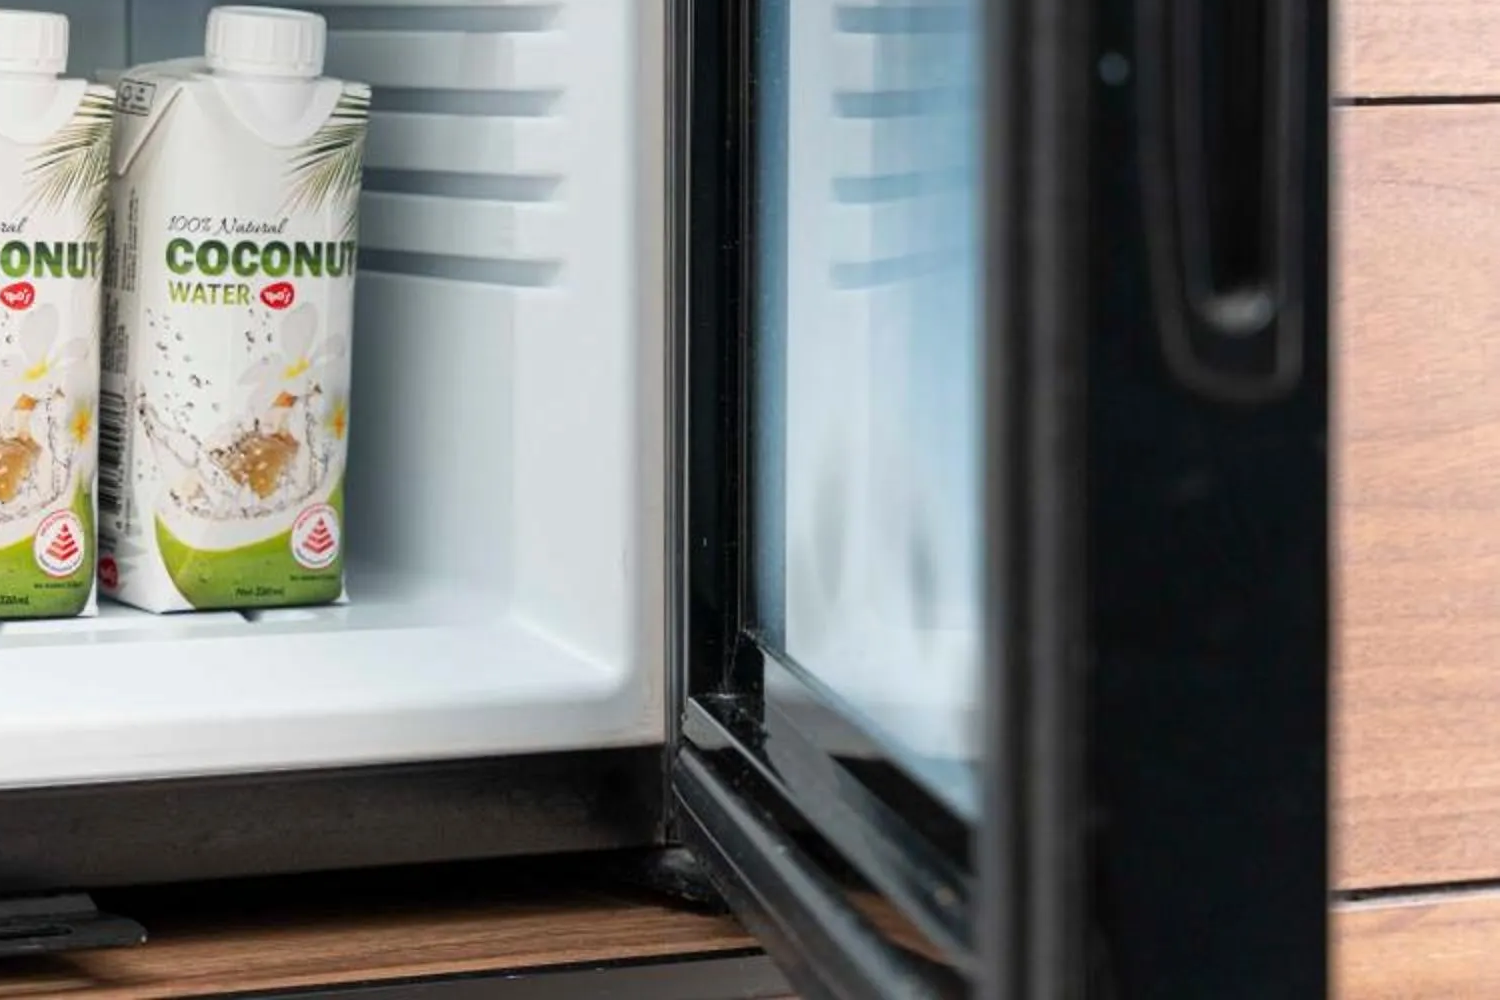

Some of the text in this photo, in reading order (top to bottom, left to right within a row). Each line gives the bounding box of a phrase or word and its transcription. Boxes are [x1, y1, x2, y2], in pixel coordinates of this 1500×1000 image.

[167, 216, 288, 235] 100% Natural
[165, 237, 356, 278] COCONUT
[168, 281, 250, 306] WATER
